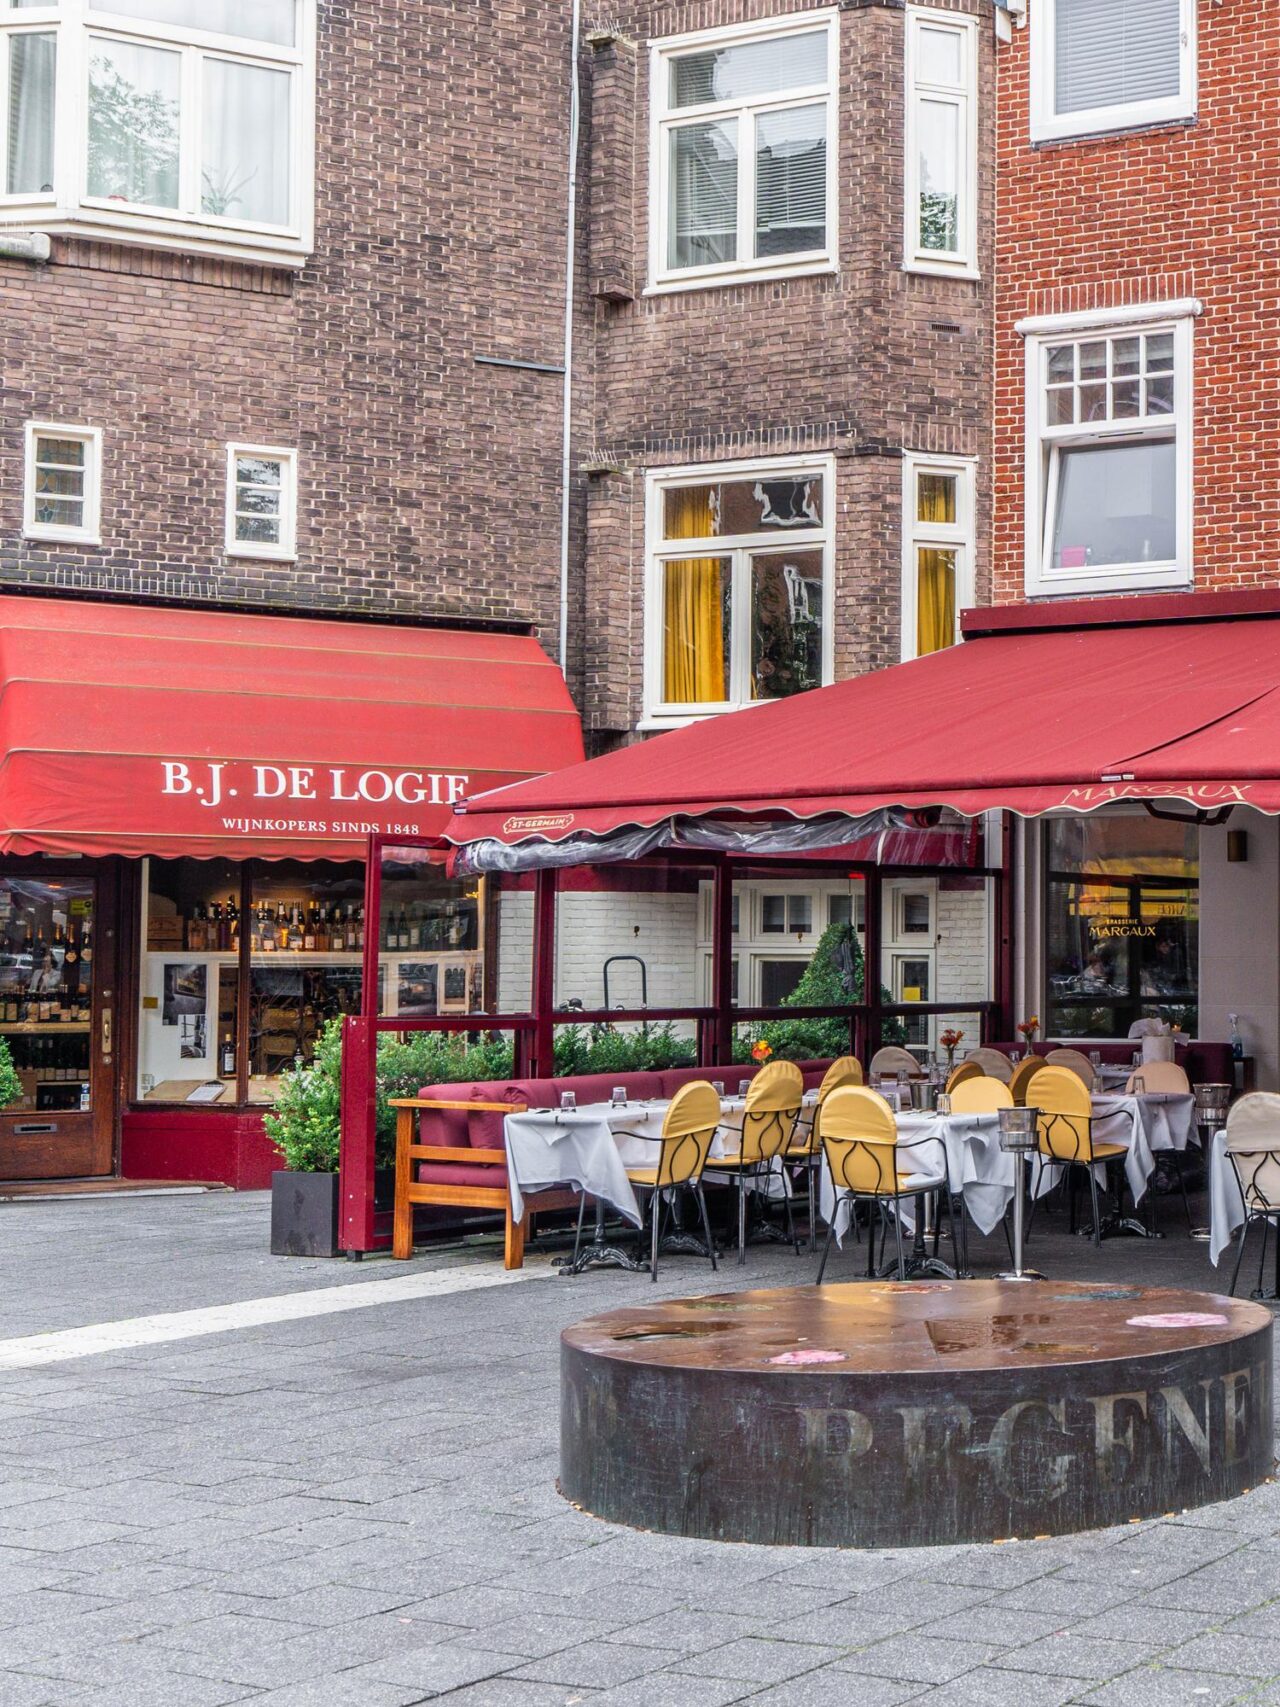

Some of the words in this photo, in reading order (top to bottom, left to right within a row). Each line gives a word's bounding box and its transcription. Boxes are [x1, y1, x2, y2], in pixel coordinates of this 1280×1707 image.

[160, 761, 238, 806] B.J.
[252, 765, 317, 799] DE
[1060, 785, 1252, 804] MARGAUX
[222, 817, 328, 833] WIJNKOPERS
[332, 820, 380, 834] SINDS
[386, 823, 420, 836] 1848
[511, 818, 564, 829] ST-GERMAIN
[1088, 926, 1157, 937] MARGAUX
